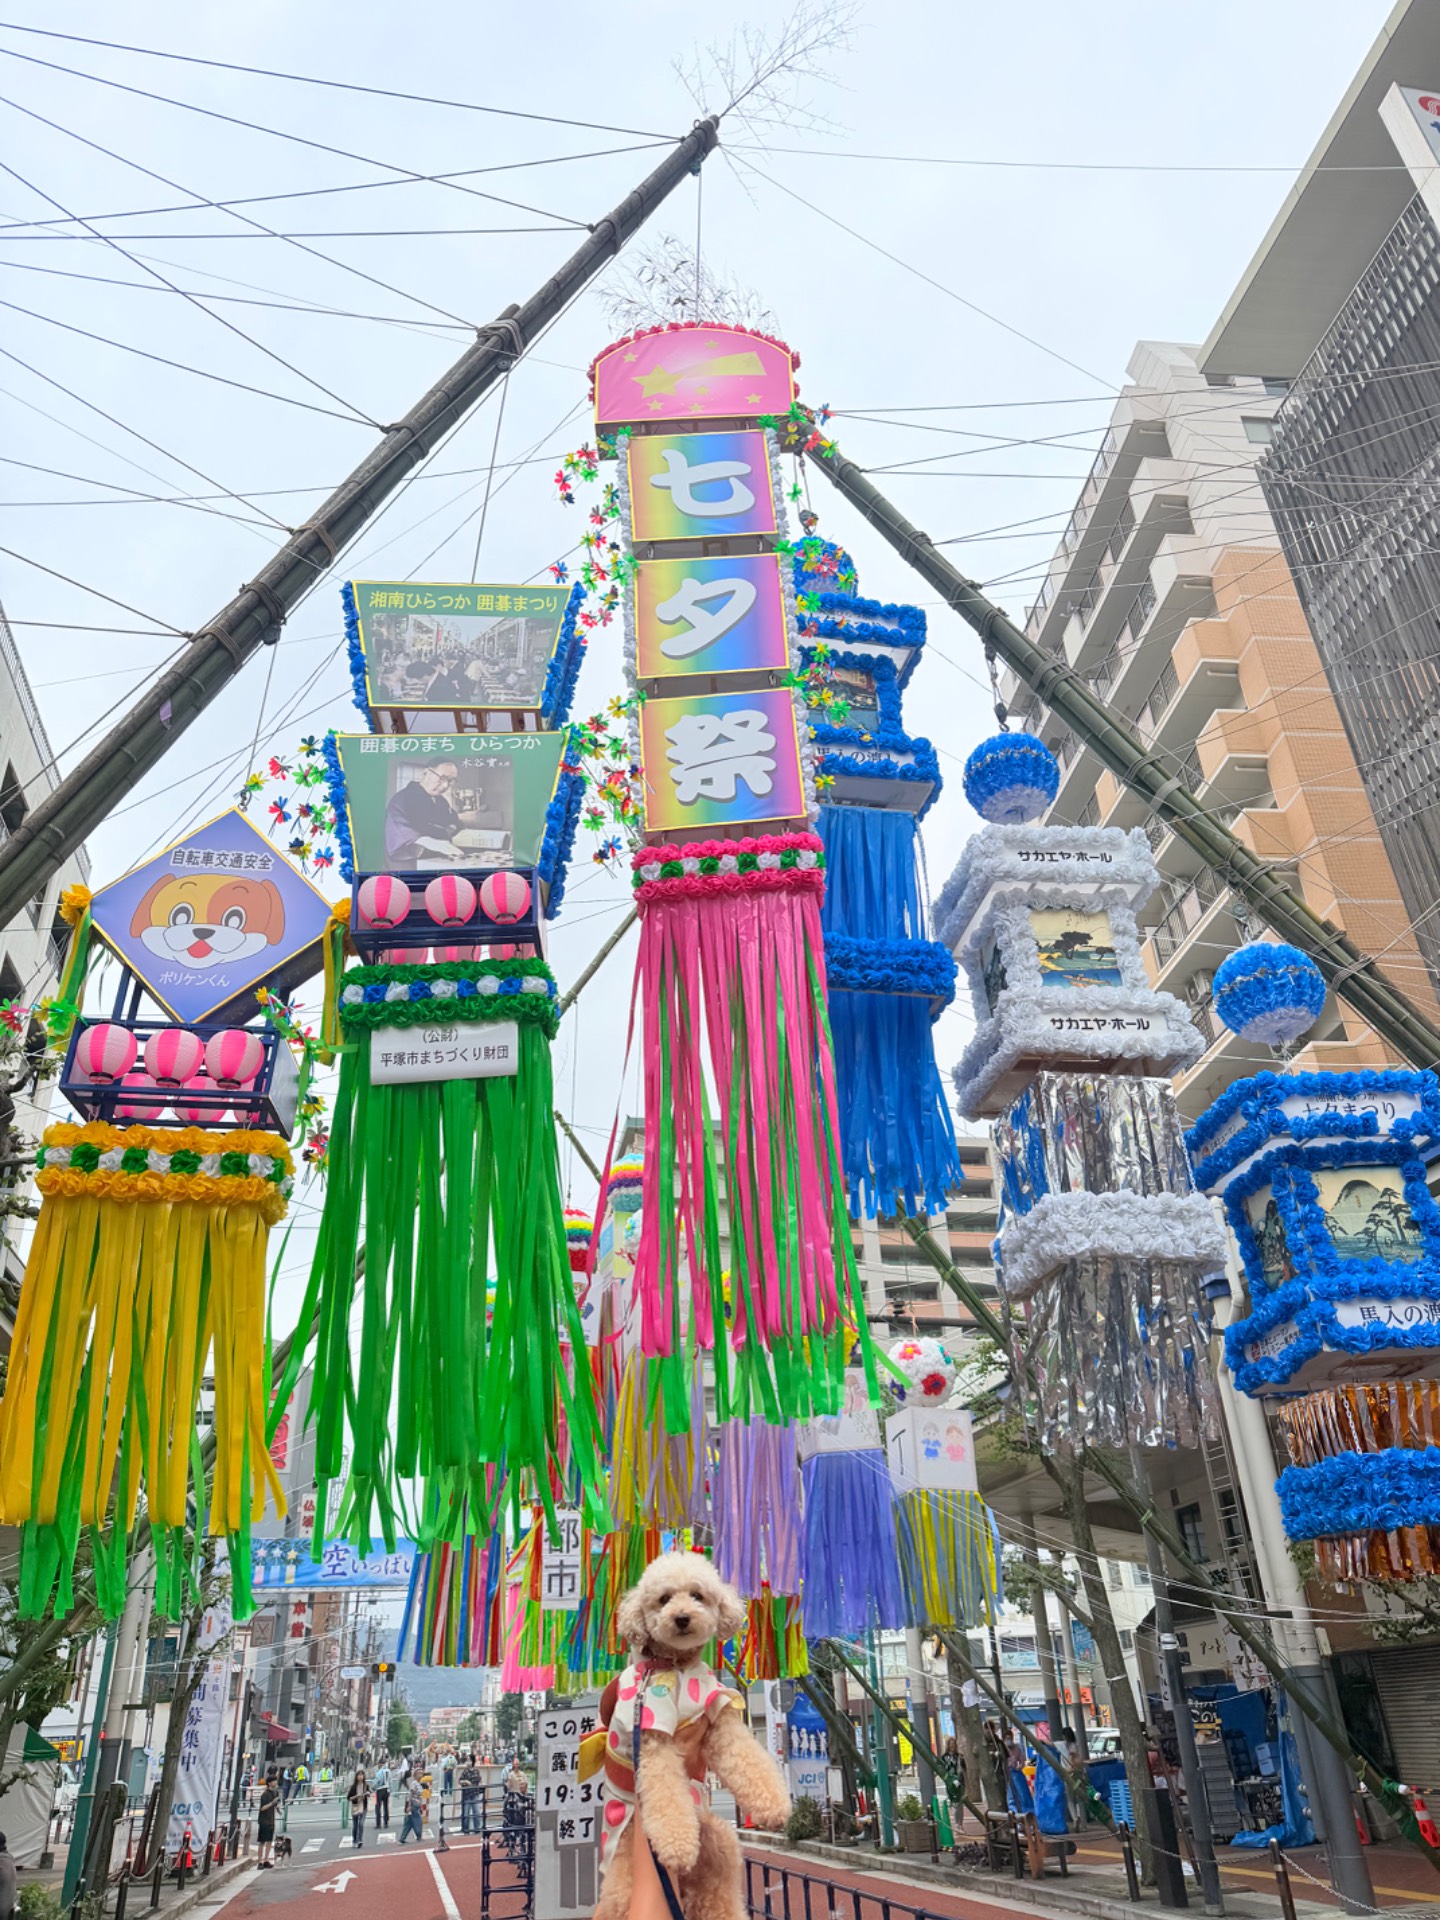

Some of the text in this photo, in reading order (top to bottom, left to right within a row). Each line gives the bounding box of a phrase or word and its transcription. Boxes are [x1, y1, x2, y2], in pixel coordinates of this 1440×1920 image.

[369, 591, 558, 613] 湘南ひらつか 囲碁まつり
[649, 449, 777, 804] 七夕祭
[360, 735, 542, 753] 囲碁のまち ひらつか
[171, 849, 273, 870] 自転車交通安全
[1017, 850, 1113, 863] サカエヤ・ホール
[159, 971, 230, 987] ポリケンくん
[1050, 1017, 1151, 1031] サカエヤ・ホール
[380, 1045, 509, 1068] 平塚市まちづくり財団
[798, 1773, 817, 1784] JCI
[559, 1816, 594, 1840] 終了
